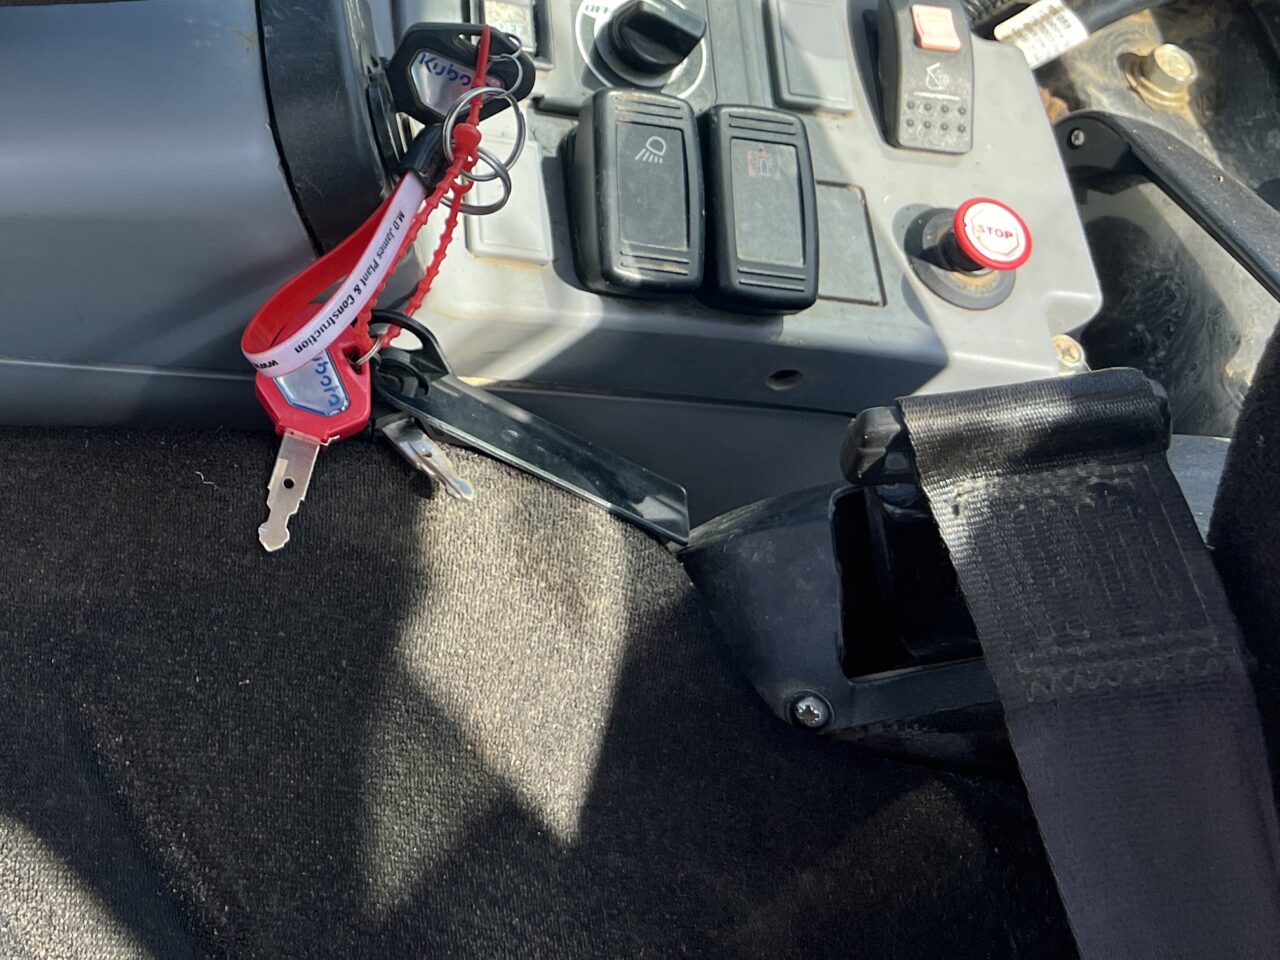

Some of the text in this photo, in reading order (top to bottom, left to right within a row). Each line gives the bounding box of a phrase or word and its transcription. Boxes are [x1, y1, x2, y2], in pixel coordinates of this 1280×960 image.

[376, 227, 396, 260] James
[976, 224, 1014, 239] STOP
[361, 260, 380, 287] Plant
[353, 283, 363, 296] &
[293, 293, 357, 355] Construction
